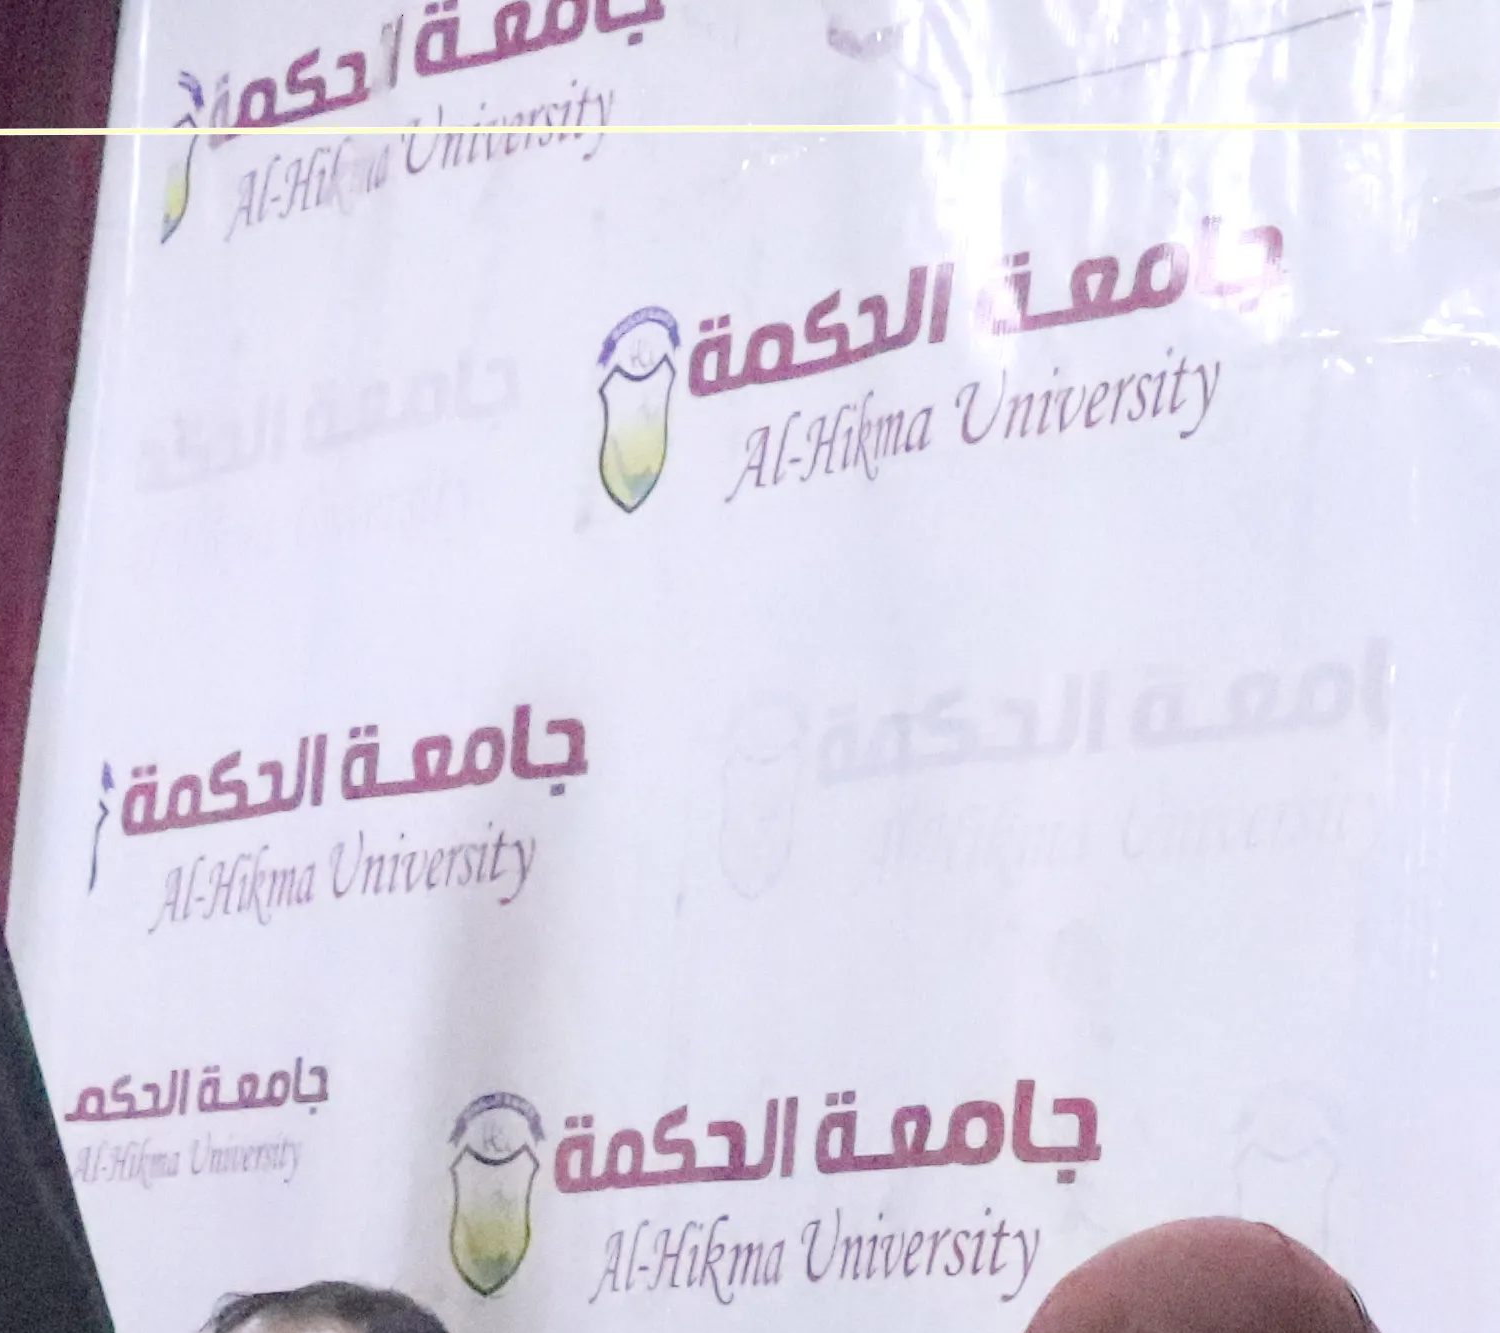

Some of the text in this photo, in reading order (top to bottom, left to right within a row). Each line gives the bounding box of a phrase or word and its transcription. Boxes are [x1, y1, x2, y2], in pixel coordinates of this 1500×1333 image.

[689, 214, 1286, 396] جامعة الحكمة
[724, 349, 1222, 504] Al-Hikma University
[121, 703, 588, 837] جامعة الحكمة
[150, 820, 537, 933] Al-Hikma University
[64, 1056, 329, 1122] جامعة الحكم
[553, 1080, 1101, 1195] جامعة الحكمة
[73, 1126, 302, 1188] Al-Hikma University
[589, 1206, 1040, 1305] Al-Hikma University
